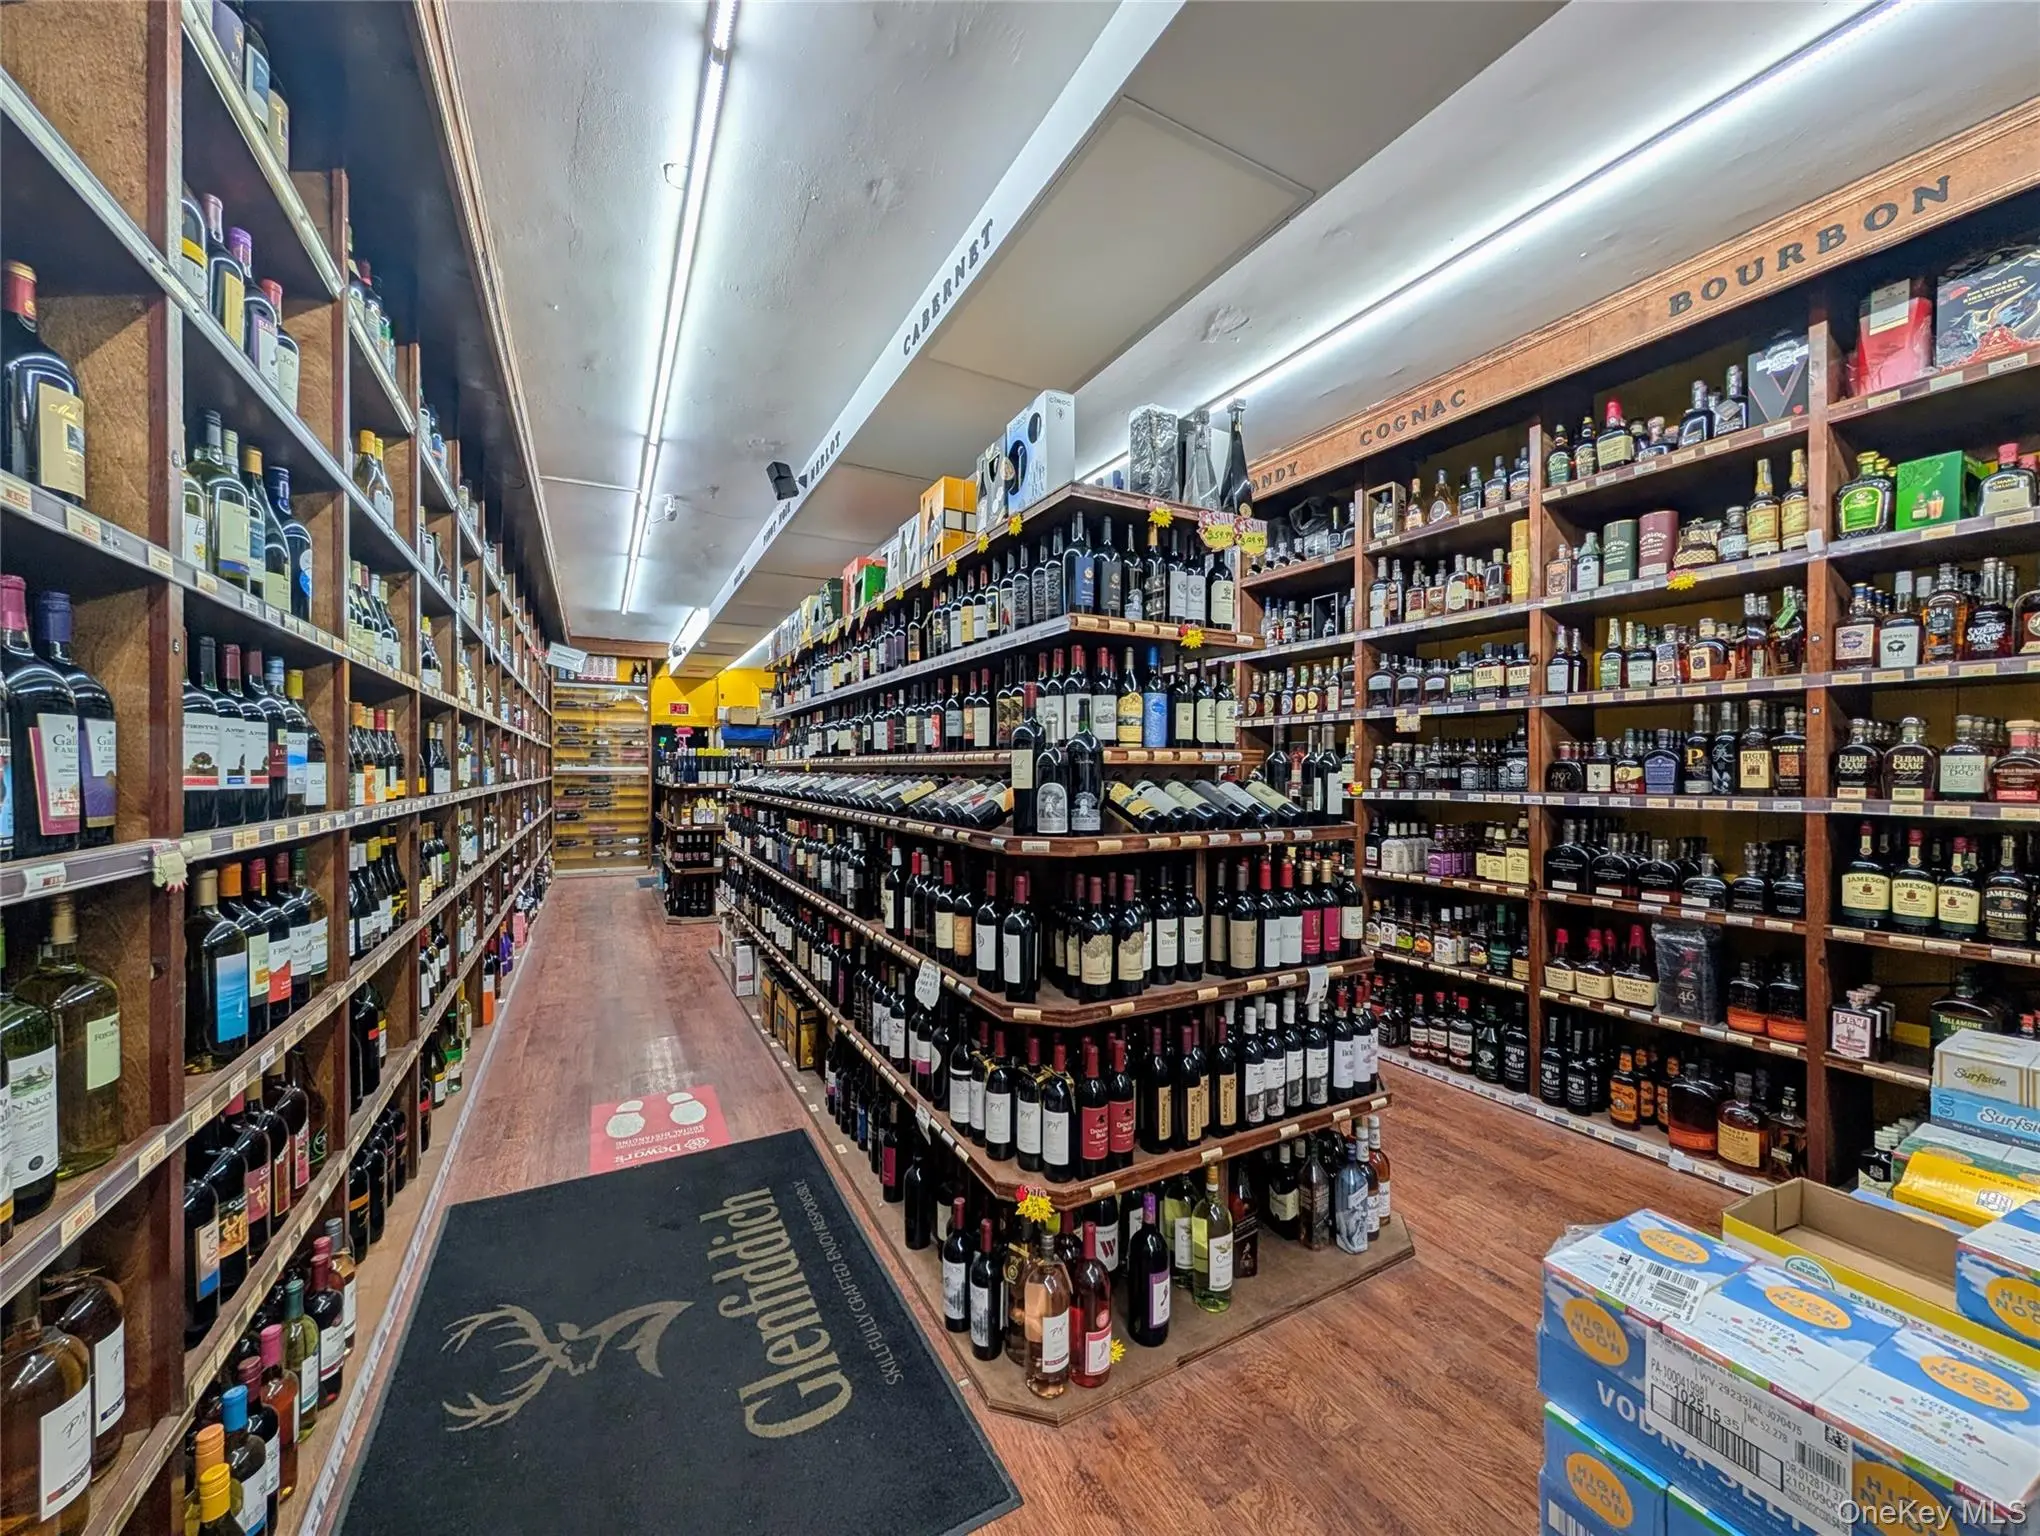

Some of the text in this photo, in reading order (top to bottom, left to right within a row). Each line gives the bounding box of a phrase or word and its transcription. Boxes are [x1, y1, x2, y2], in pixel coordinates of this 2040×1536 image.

[1669, 175, 1950, 317] BOURBON
[903, 219, 994, 356] CABERNET
[1359, 389, 1466, 447] COGNAC
[810, 431, 841, 483] MERLOT
[1687, 748, 1704, 765] P
[1838, 761, 1867, 770] CRAIG
[1839, 754, 1867, 763] ELIJAH
[1893, 754, 1925, 763] ELIJAH
[1893, 761, 1923, 770] CRAIG
[1943, 763, 1981, 772] COPPER
[1847, 876, 1886, 885] JAMESON
[1894, 882, 1933, 892] JAMESON
[1986, 890, 2028, 901] JAMESON
[2004, 912, 2027, 921] BARREL
[1678, 990, 1696, 1002] 46
[1938, 1013, 1983, 1030] TULLAMORE
[1953, 1067, 2007, 1087] Surfside
[1980, 1107, 2040, 1134] Surfsi
[818, 1231, 842, 1262] ENJOY
[1100, 1238, 1117, 1258] W
[1800, 1261, 1819, 1273] SURF
[2000, 1288, 2040, 1311] HIG
[700, 1187, 853, 1439] Glenfiddich
[1573, 1308, 1617, 1340] HIGH
[1995, 1298, 2040, 1328] NOO
[854, 1310, 904, 1385] SKILLFULLY
[1570, 1319, 1622, 1356] NOON
[1929, 1364, 2015, 1407] NOON
[1943, 1361, 2012, 1398] HIGH
[1576, 1463, 1621, 1500] HIGH
[1572, 1472, 1626, 1521] NOON
